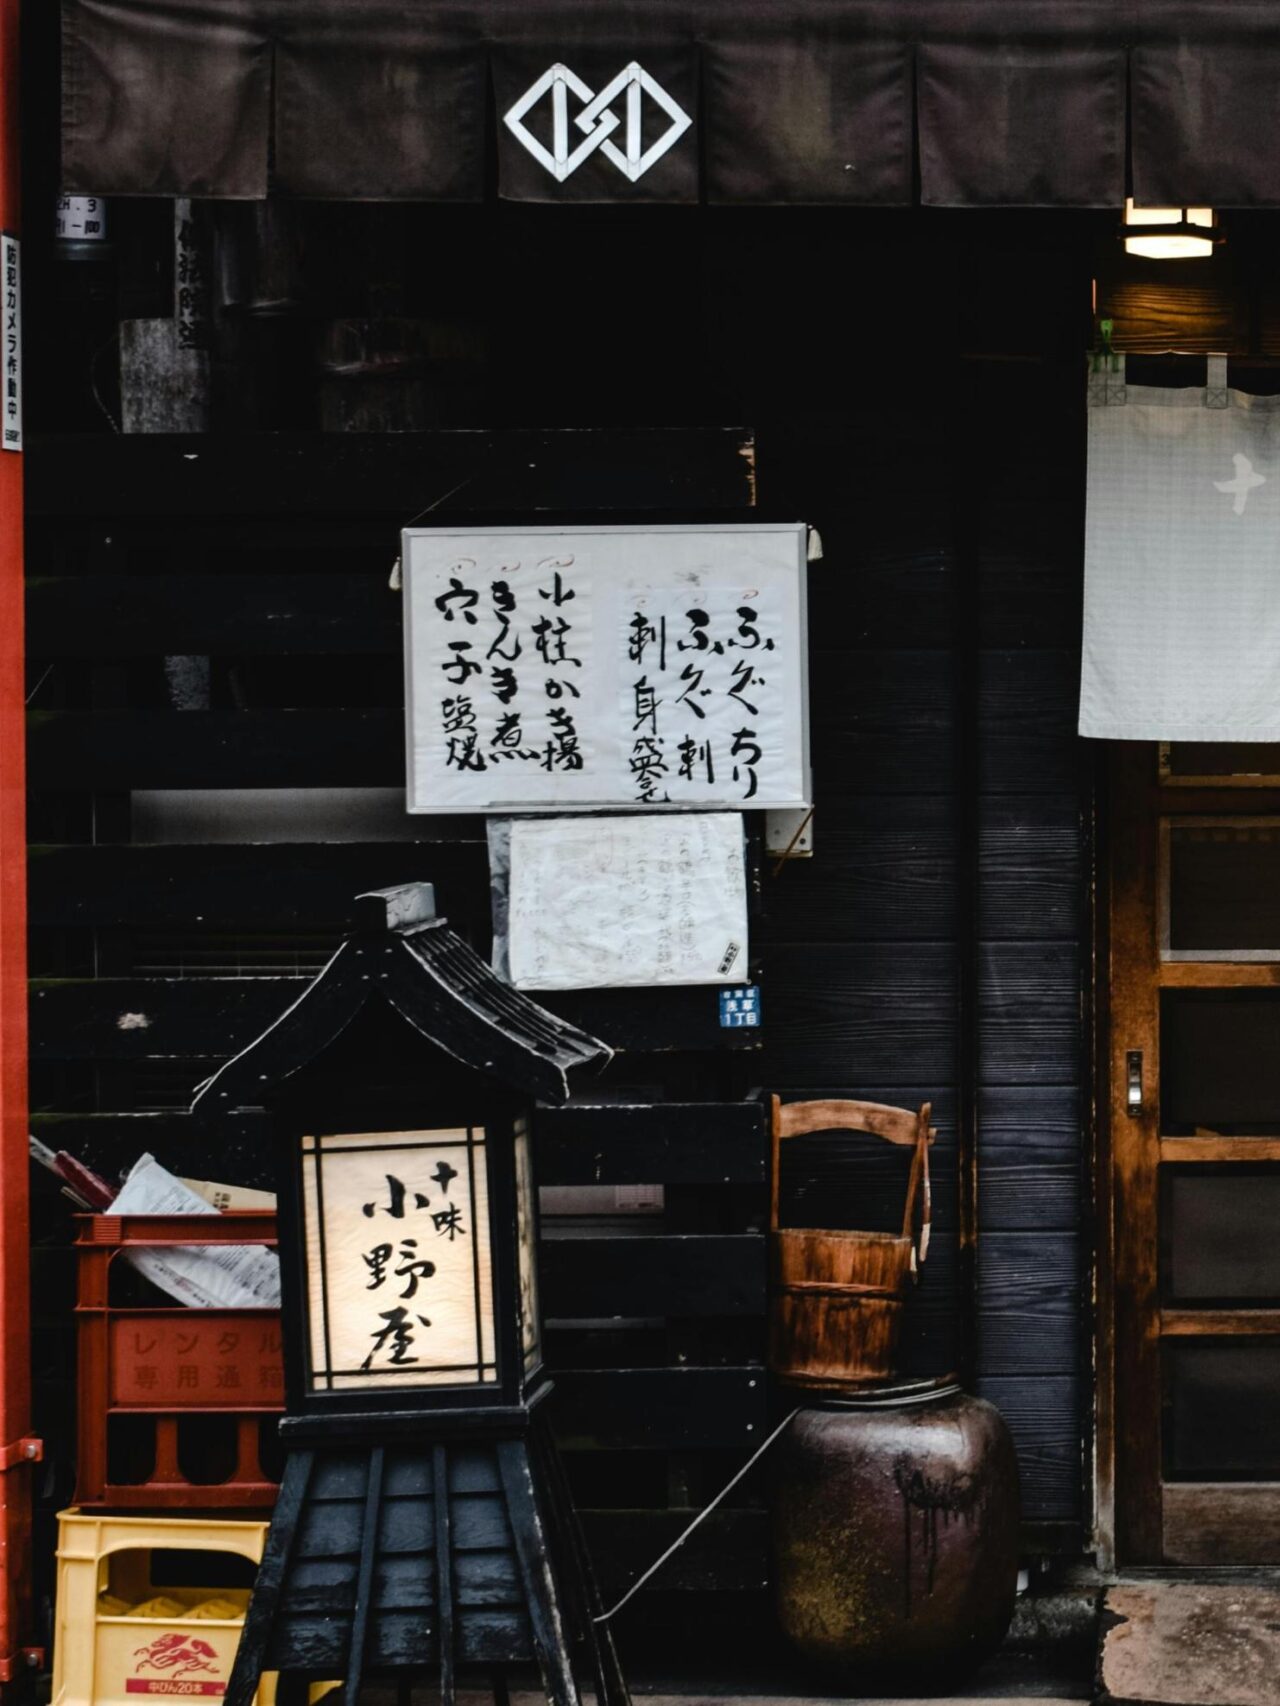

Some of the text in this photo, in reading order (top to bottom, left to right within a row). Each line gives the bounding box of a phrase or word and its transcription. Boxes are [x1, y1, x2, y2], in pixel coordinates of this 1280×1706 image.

[675, 608, 725, 785] ふぐ刺
[727, 606, 775, 800] ふぐちり
[360, 1174, 436, 1371] 小野屋
[430, 1161, 467, 1242] 十味
[134, 1331, 282, 1355] レンタル
